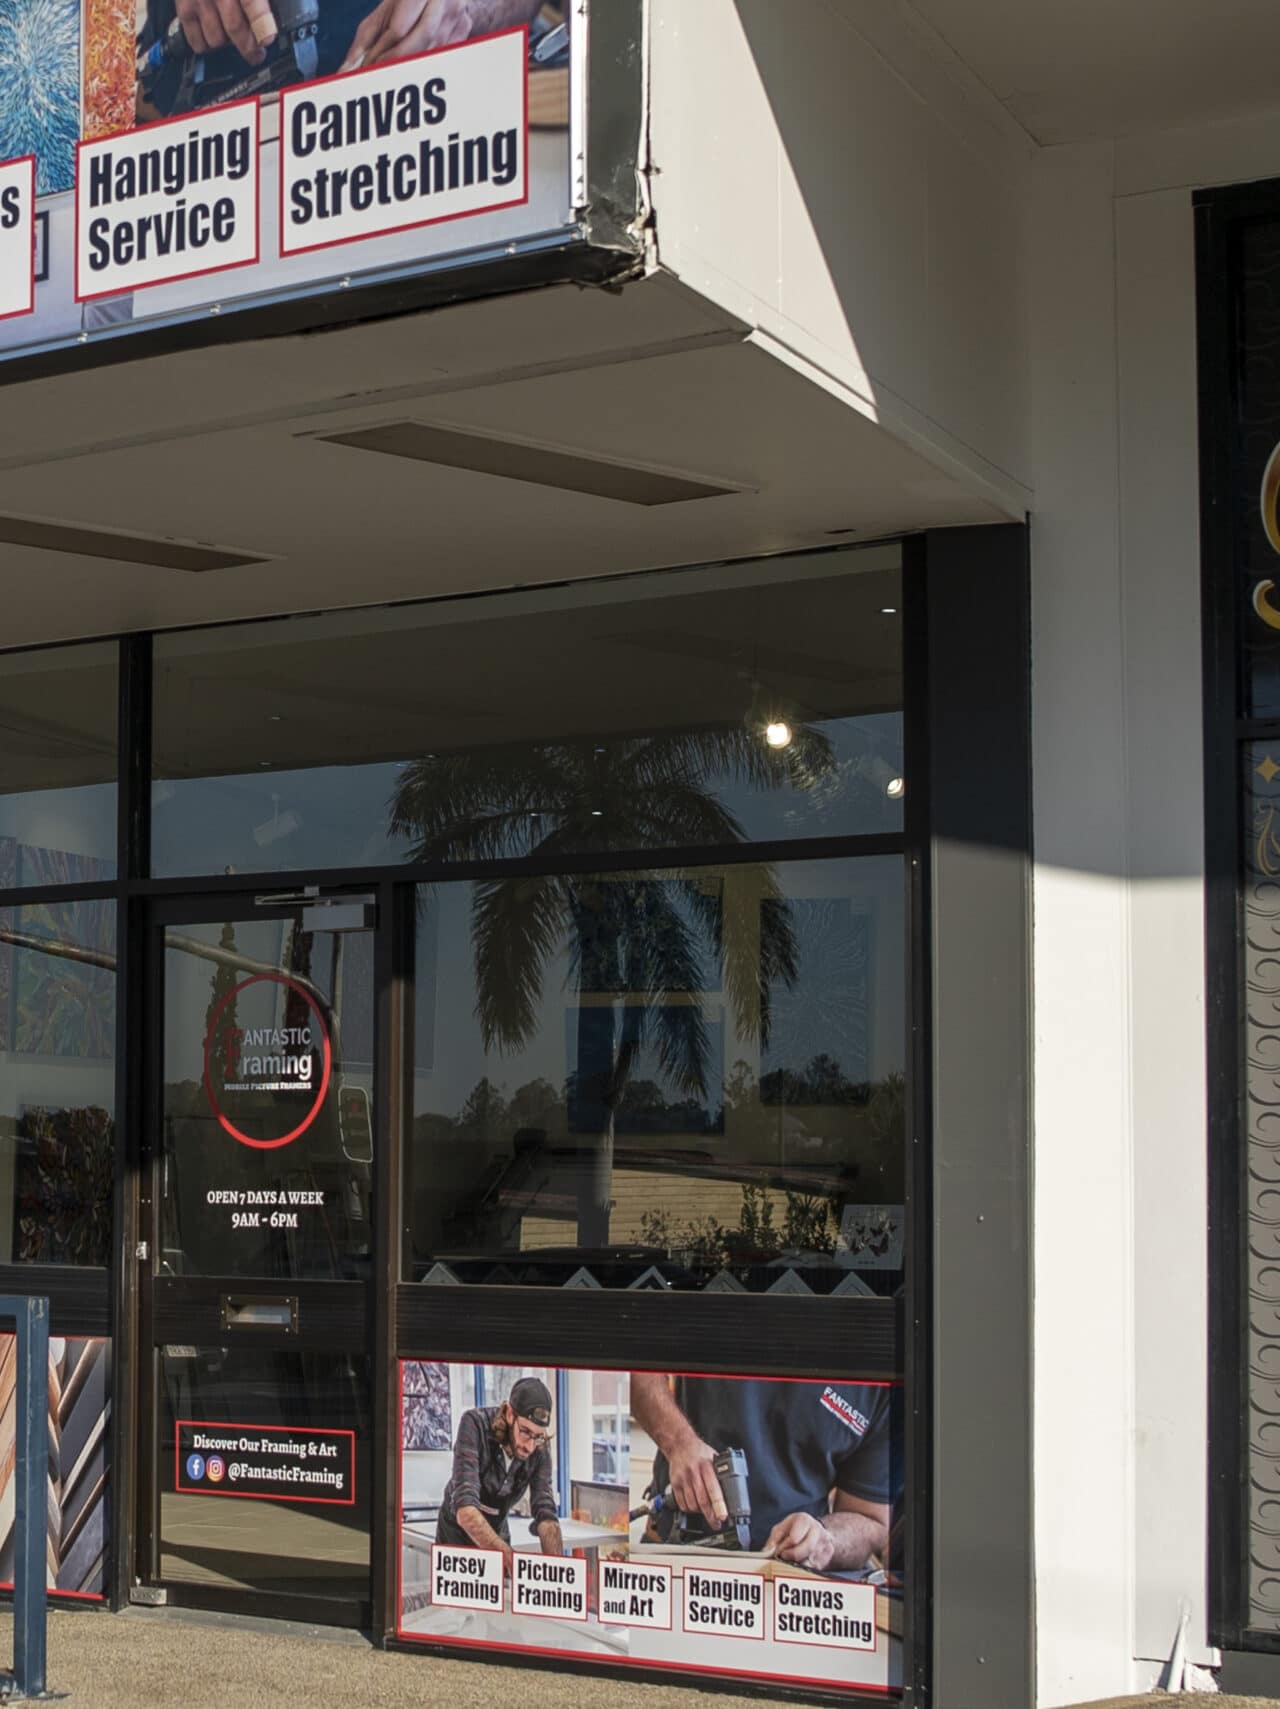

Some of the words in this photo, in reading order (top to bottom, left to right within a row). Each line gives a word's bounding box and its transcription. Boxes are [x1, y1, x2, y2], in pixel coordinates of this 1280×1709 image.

[291, 77, 447, 158] Canvas
[89, 126, 251, 207] Hanging
[291, 127, 519, 225] stretching
[88, 197, 236, 272] Service
[207, 1191, 239, 1204] OPEN
[239, 1193, 246, 1206] 7
[247, 1191, 278, 1204] DAYS
[278, 1192, 288, 1205] A
[287, 1191, 325, 1206] WEEK
[231, 1212, 261, 1229] 9AM
[270, 1211, 299, 1228] 6PM
[823, 1385, 870, 1429] FANTASTIC
[193, 1433, 239, 1451] Discover
[239, 1436, 261, 1453] Our
[261, 1439, 306, 1459] Framing
[308, 1441, 318, 1456] &
[318, 1442, 338, 1458] Art
[228, 1463, 343, 1488] @FantasticFraming
[436, 1551, 487, 1578] Jersey
[517, 1558, 576, 1585] Picture
[603, 1566, 667, 1593] Mirrors
[436, 1575, 500, 1605] Framing
[517, 1583, 583, 1613] Framing
[688, 1574, 762, 1605] Hanging
[778, 1582, 844, 1610] Canvas
[603, 1599, 626, 1615] and
[628, 1595, 655, 1618] Art
[688, 1599, 756, 1629] Service
[777, 1611, 873, 1643] stretching
